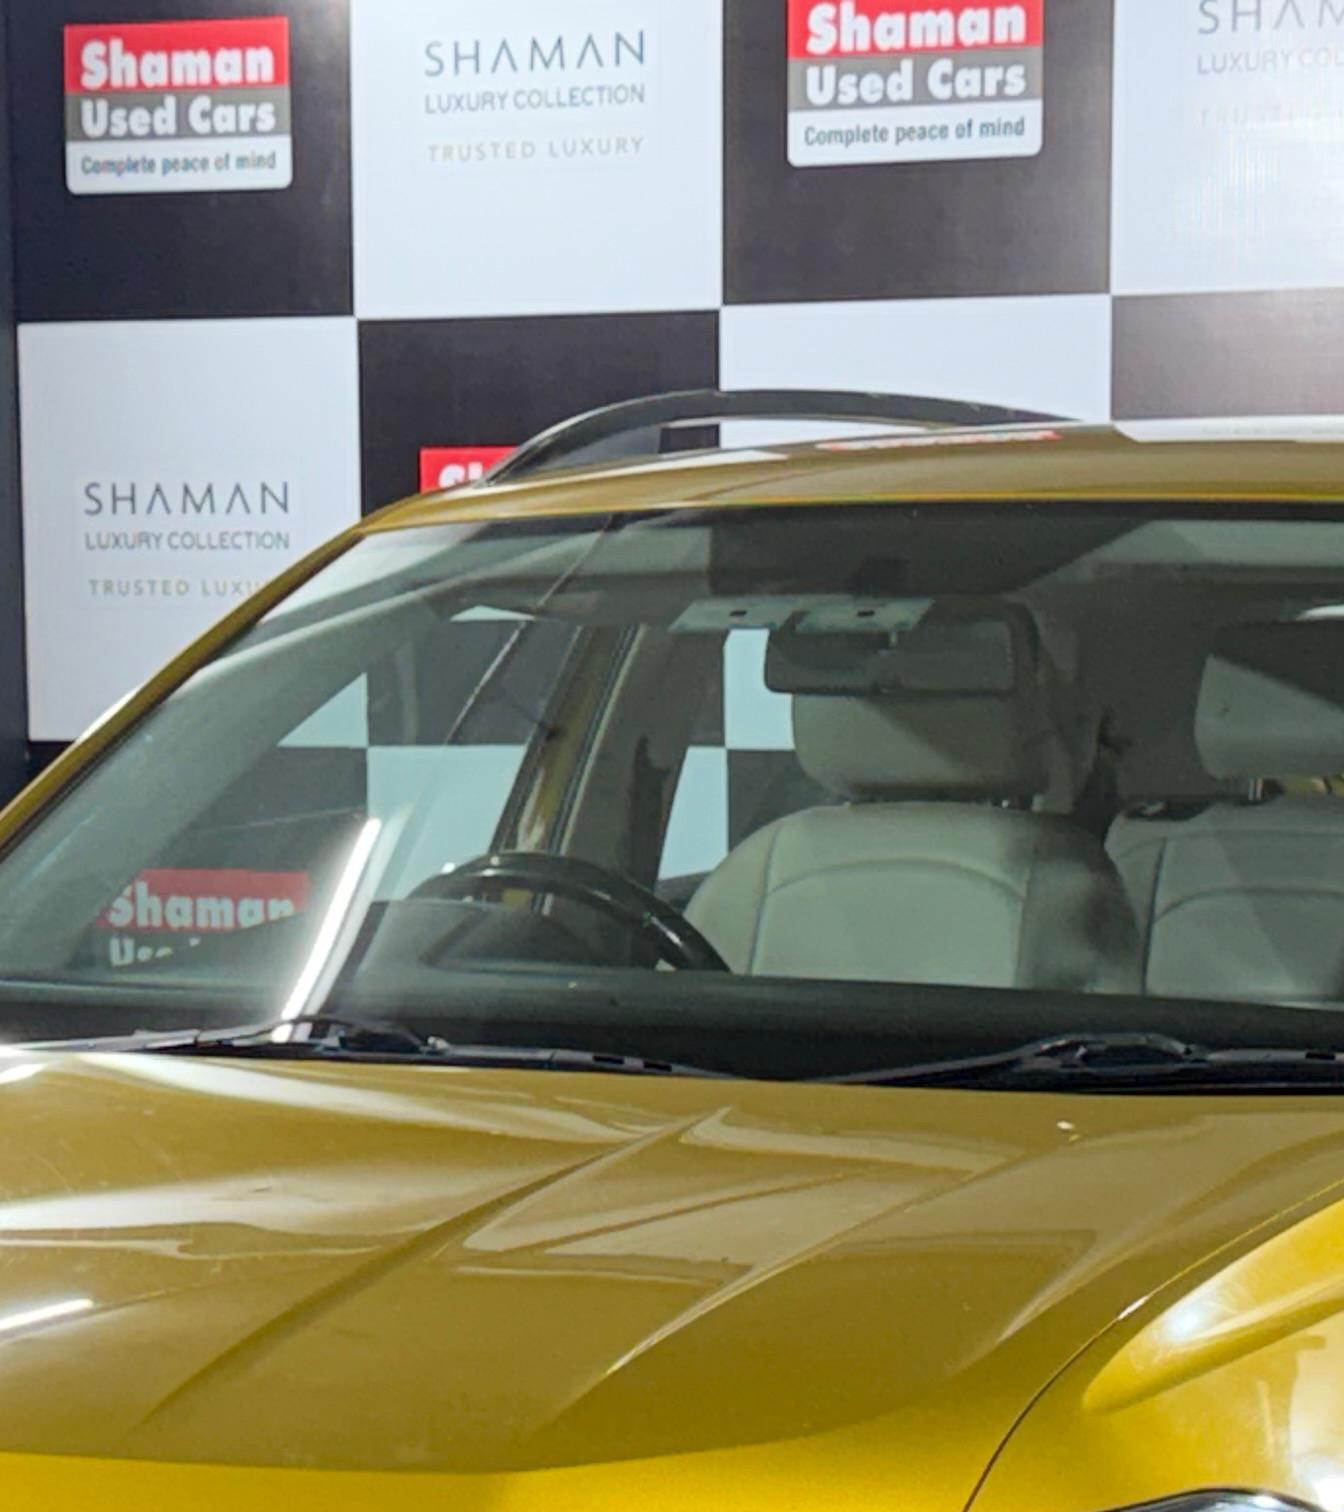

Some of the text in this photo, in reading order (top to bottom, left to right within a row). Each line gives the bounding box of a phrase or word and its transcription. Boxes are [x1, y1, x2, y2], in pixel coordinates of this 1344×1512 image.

[806, 0, 1026, 55] Shaman
[80, 37, 274, 90] Shaman
[425, 29, 644, 77] SHAMAN
[1197, 49, 1292, 75] LUXURY
[806, 58, 1026, 106] Used Cars
[425, 83, 644, 115] LUXURY COLLECTION
[81, 95, 276, 138] Used Cars
[804, 116, 1025, 148] Complete peace of mind
[81, 151, 276, 176] Complete peace of mind
[428, 136, 644, 162] TRUSTED LUXURY
[84, 481, 290, 516] SHAMAN
[85, 530, 290, 551] LUXURY COLLECTION
[89, 579, 189, 597] TRUSTED
